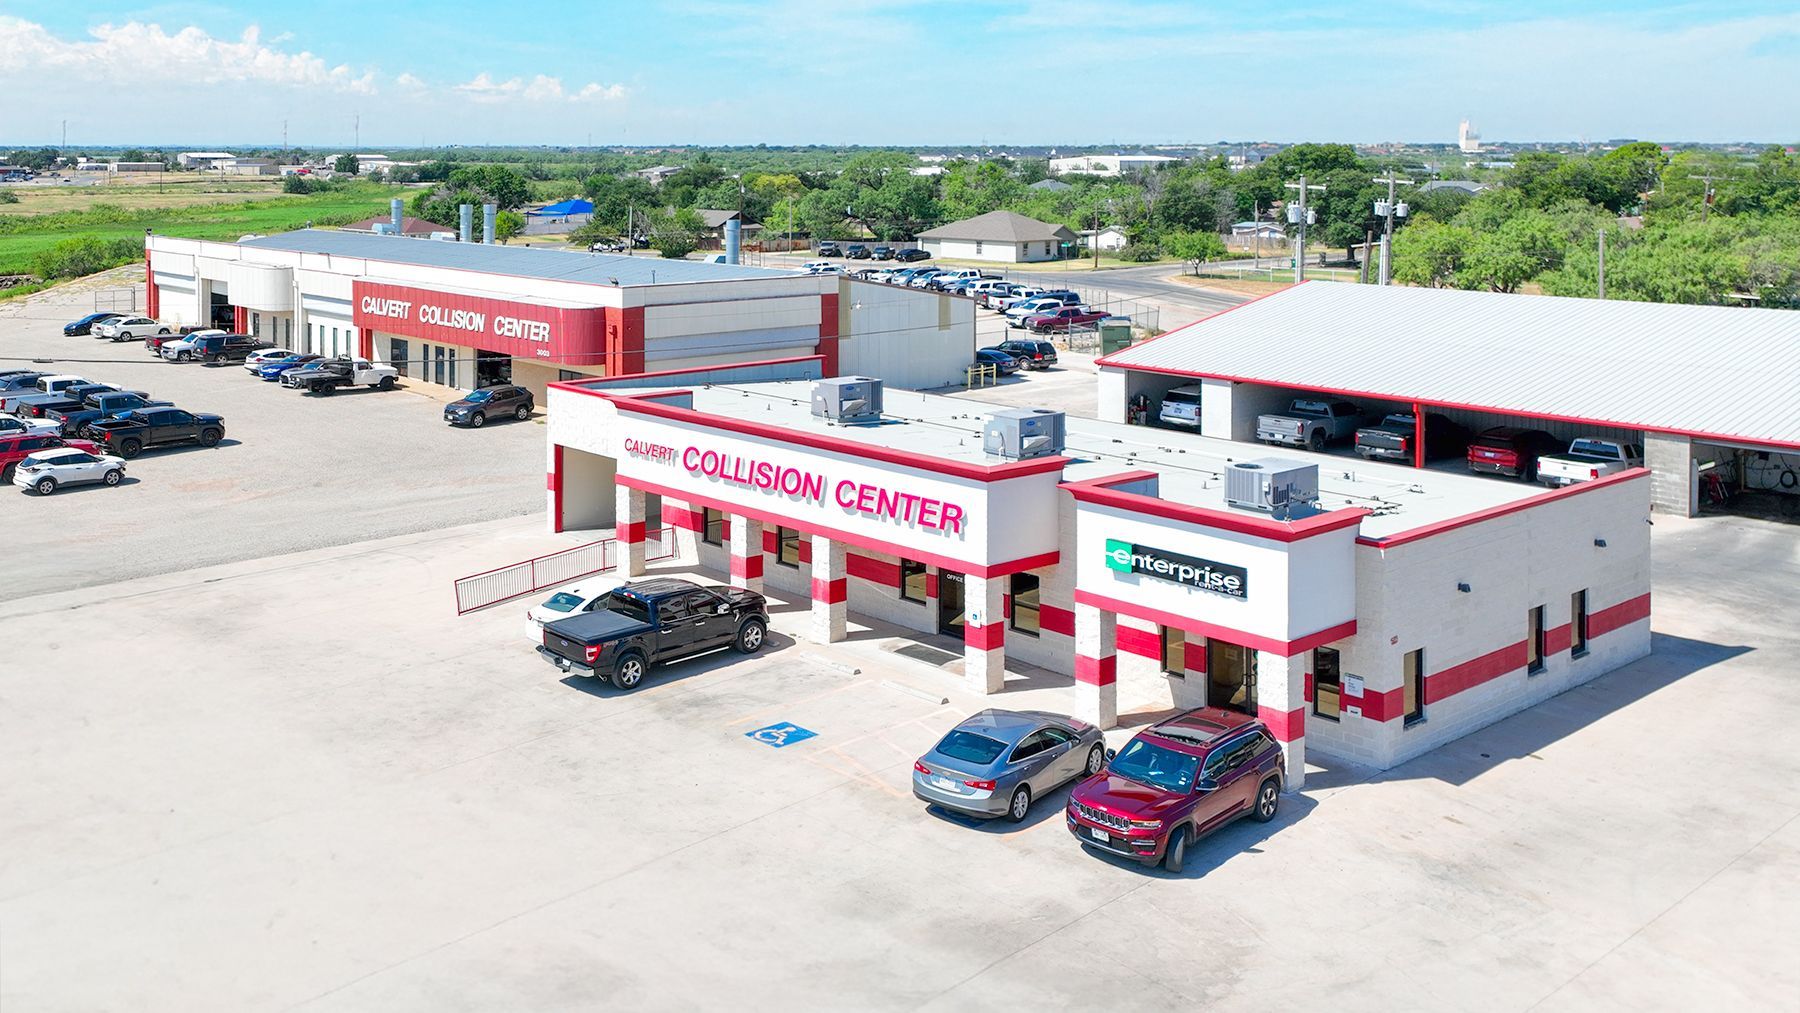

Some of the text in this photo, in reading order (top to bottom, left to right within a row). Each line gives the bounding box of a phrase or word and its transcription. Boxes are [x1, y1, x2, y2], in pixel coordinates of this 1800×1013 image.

[361, 296, 550, 342] CALVERT COLLISION CENTER
[624, 438, 965, 534] CALVERT COLLISION CENTER
[946, 573, 964, 583] OFFICE
[1107, 549, 1241, 590] enterprise
